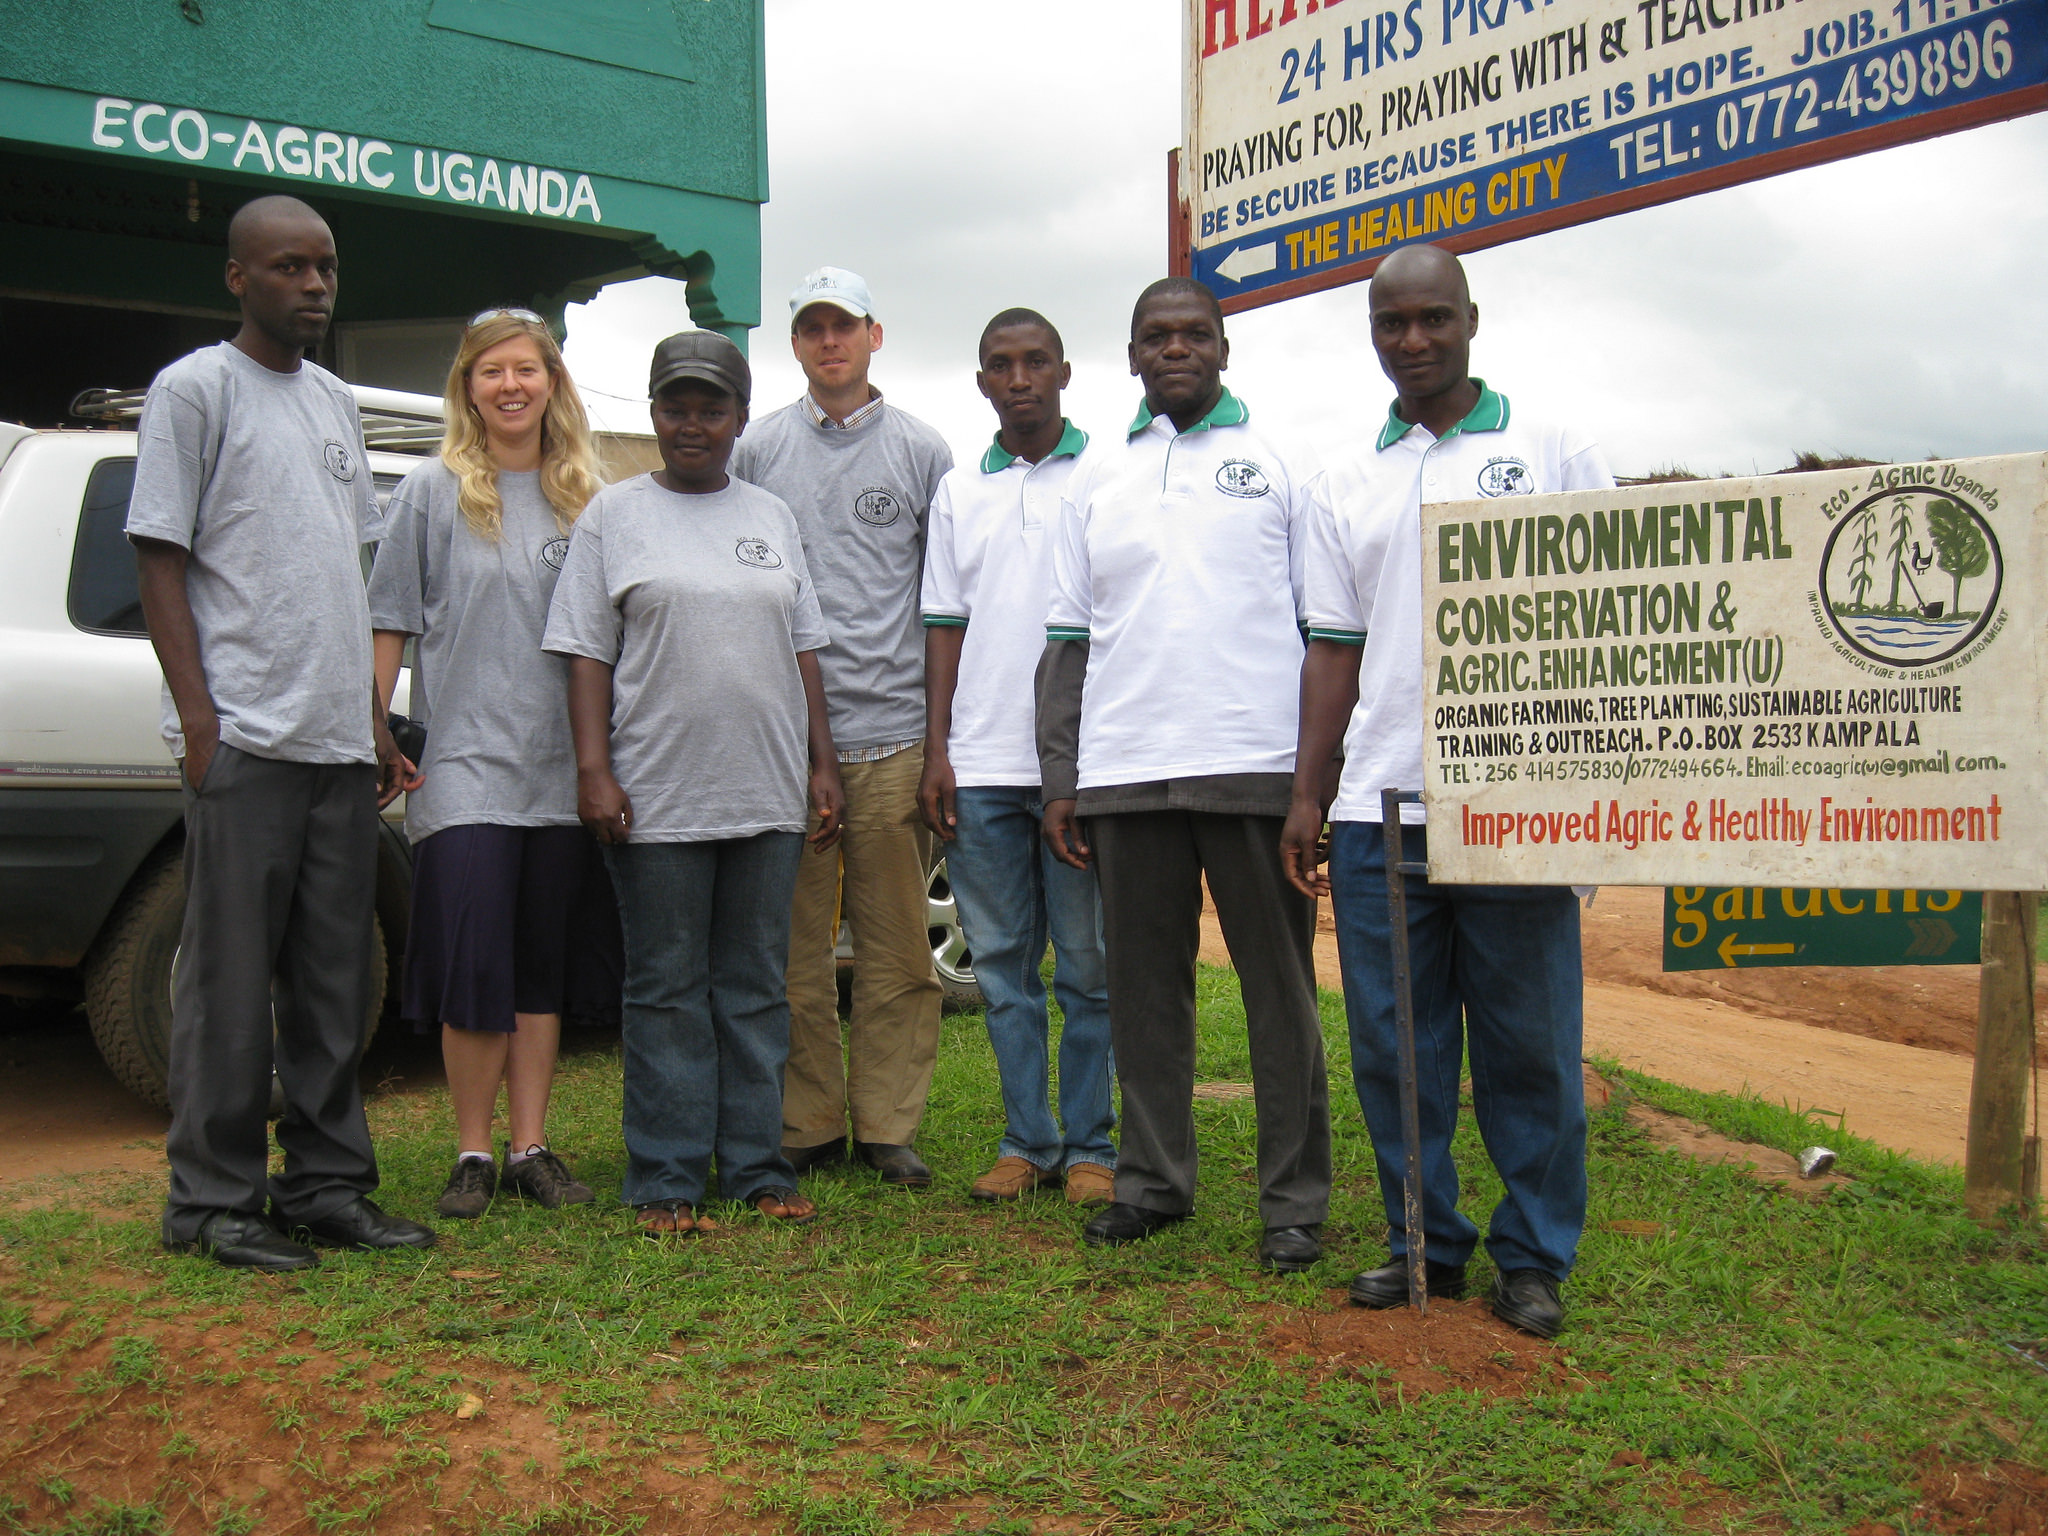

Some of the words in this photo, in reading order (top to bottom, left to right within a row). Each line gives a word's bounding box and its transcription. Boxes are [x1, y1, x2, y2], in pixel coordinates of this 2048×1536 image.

[1277, 38, 1326, 105] 24
[1343, 0, 1423, 82] HRS
[1201, 205, 1229, 238] BE
[1236, 173, 1336, 226] SECURE
[1346, 132, 1476, 195] BECAUSE
[1485, 95, 1592, 154] THERE
[1603, 81, 1635, 120] IS
[1648, 46, 1764, 107] HOPE.
[1203, 121, 1302, 192] PRAYING
[1313, 102, 1371, 156] FOR,
[1381, 55, 1502, 136] PRAYING
[1510, 22, 1588, 93] WITH
[1600, 17, 1629, 64] &
[1610, 120, 1700, 180] TEL:
[1716, 19, 2013, 151] 0772-439896
[92, 98, 395, 188] ECO-AGRIC
[413, 150, 602, 222] UGANDA
[1285, 221, 1340, 270] THE
[1347, 181, 1476, 255] HEALING
[1487, 153, 1568, 214] CITY
[1940, 464, 1999, 513] Uganda
[1438, 496, 1792, 583] ENVIRONMENTAL
[1435, 580, 1700, 647] CONSERVATION
[1707, 580, 1738, 634] &
[1806, 589, 1833, 640] IMPROVED
[1829, 640, 1895, 679] AGRICULTURE
[1434, 703, 1509, 730] ORGANIC
[1846, 686, 1962, 715] AGRICULTURE
[1437, 732, 1523, 758] TRAINING
[1529, 732, 1542, 755] &
[1546, 727, 1653, 754] OUTREACH.
[1752, 724, 1801, 748] 2533
[1807, 720, 1920, 747] KAMPALA
[1485, 762, 1518, 782] 256
[1462, 800, 1600, 849] Improved
[1605, 799, 1673, 850] Agric
[1682, 800, 1702, 841] &
[1710, 798, 1812, 847] Healthy
[1819, 794, 2003, 843] Environment
